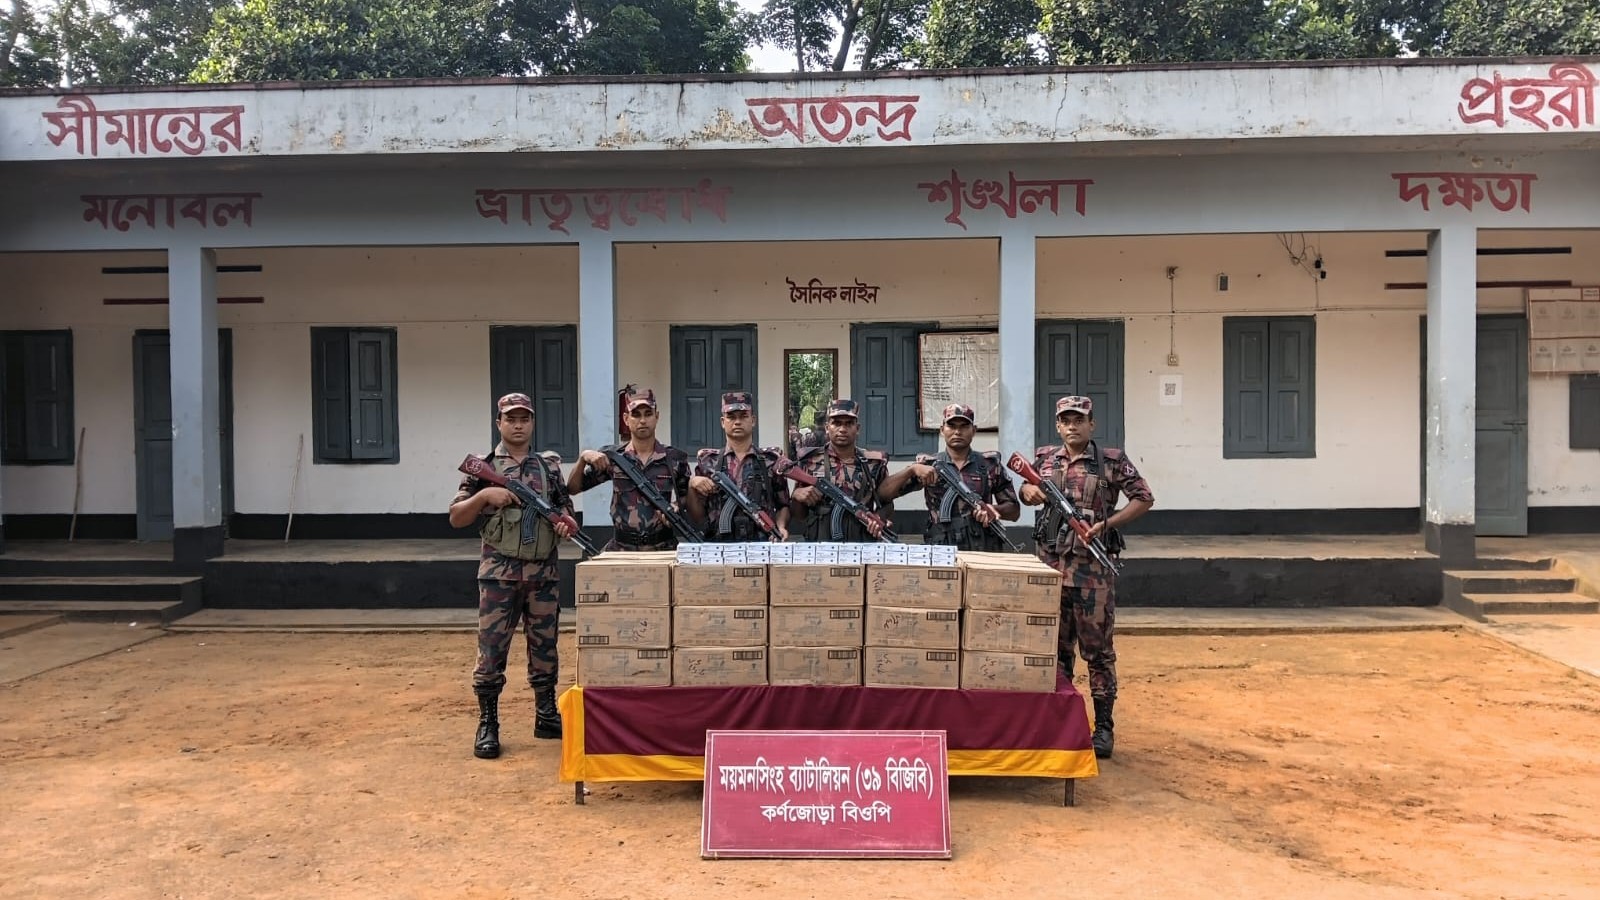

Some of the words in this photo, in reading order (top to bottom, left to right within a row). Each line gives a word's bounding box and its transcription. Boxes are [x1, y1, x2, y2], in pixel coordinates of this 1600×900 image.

[42, 94, 246, 157] সীমান্তের
[745, 94, 921, 144] অতন্দ্র
[1458, 62, 1599, 132] প্রহরী
[81, 192, 263, 232] মনোবল
[917, 169, 1096, 231] শৃঙ্খলা
[1391, 172, 1538, 213] দক্ষতা
[785, 276, 838, 305] সৈনিক
[839, 276, 881, 305] লাইন
[719, 756, 785, 795] ময়মনসিংহ
[788, 756, 851, 793] ব্যাটালিয়ন
[855, 761, 882, 800] (৩৯
[886, 757, 934, 801] বিজিবি)
[760, 799, 835, 826] কর্ণজোড়া
[840, 800, 893, 824] বিওপি
